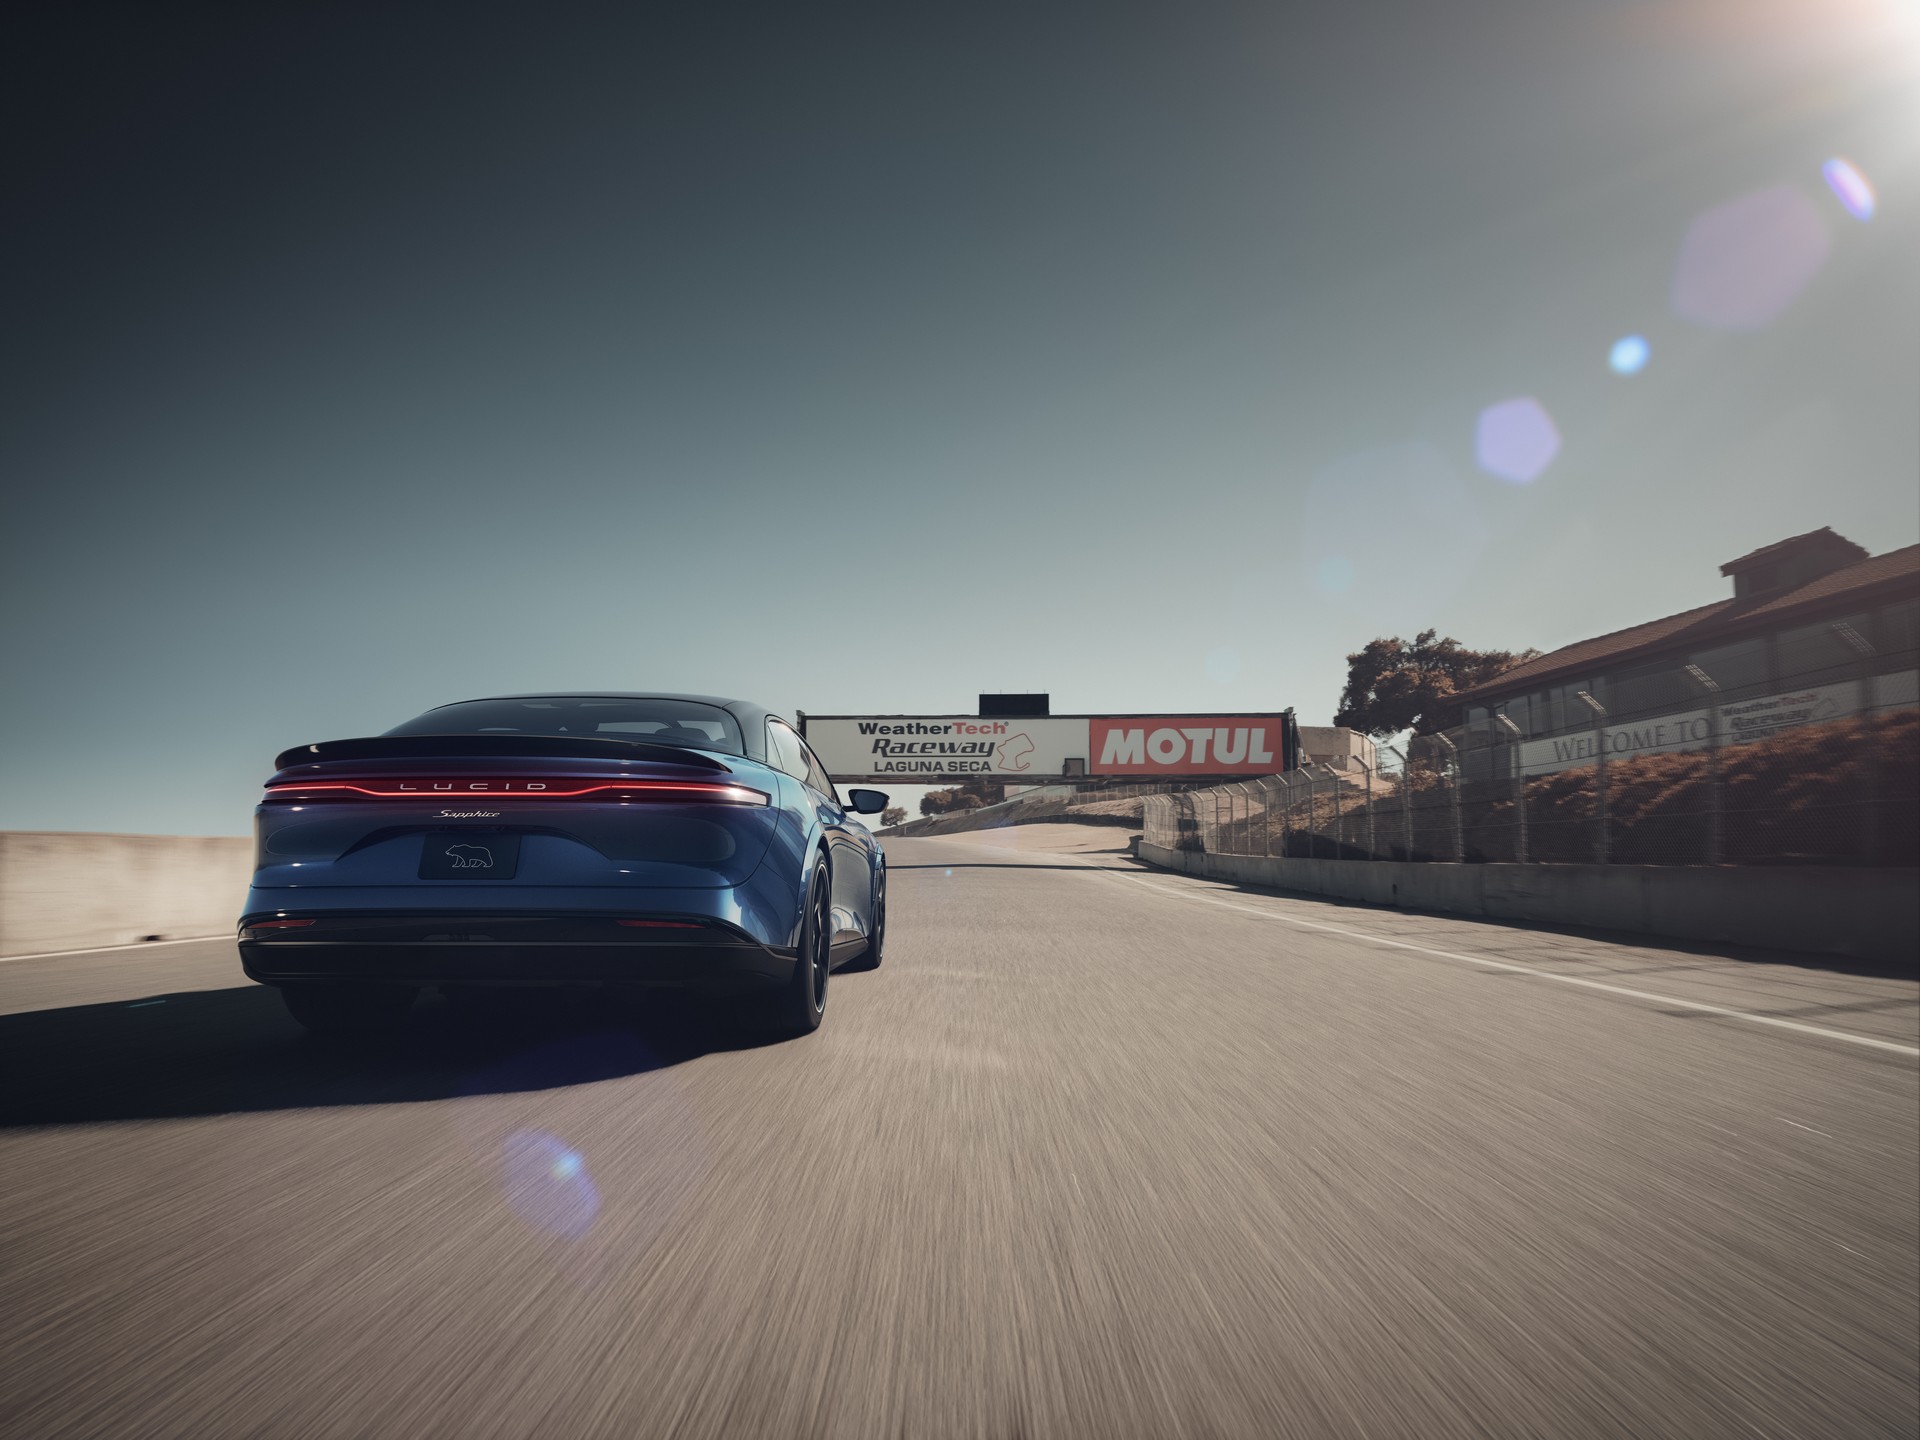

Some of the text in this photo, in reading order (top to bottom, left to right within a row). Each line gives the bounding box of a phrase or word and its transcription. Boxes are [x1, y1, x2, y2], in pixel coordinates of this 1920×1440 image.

[1674, 717, 1713, 743] TO
[871, 738, 996, 758] Raceway
[1099, 727, 1274, 765] MOTUL
[873, 761, 992, 773] LAGUNA SECA
[432, 809, 500, 819] Sapphire
